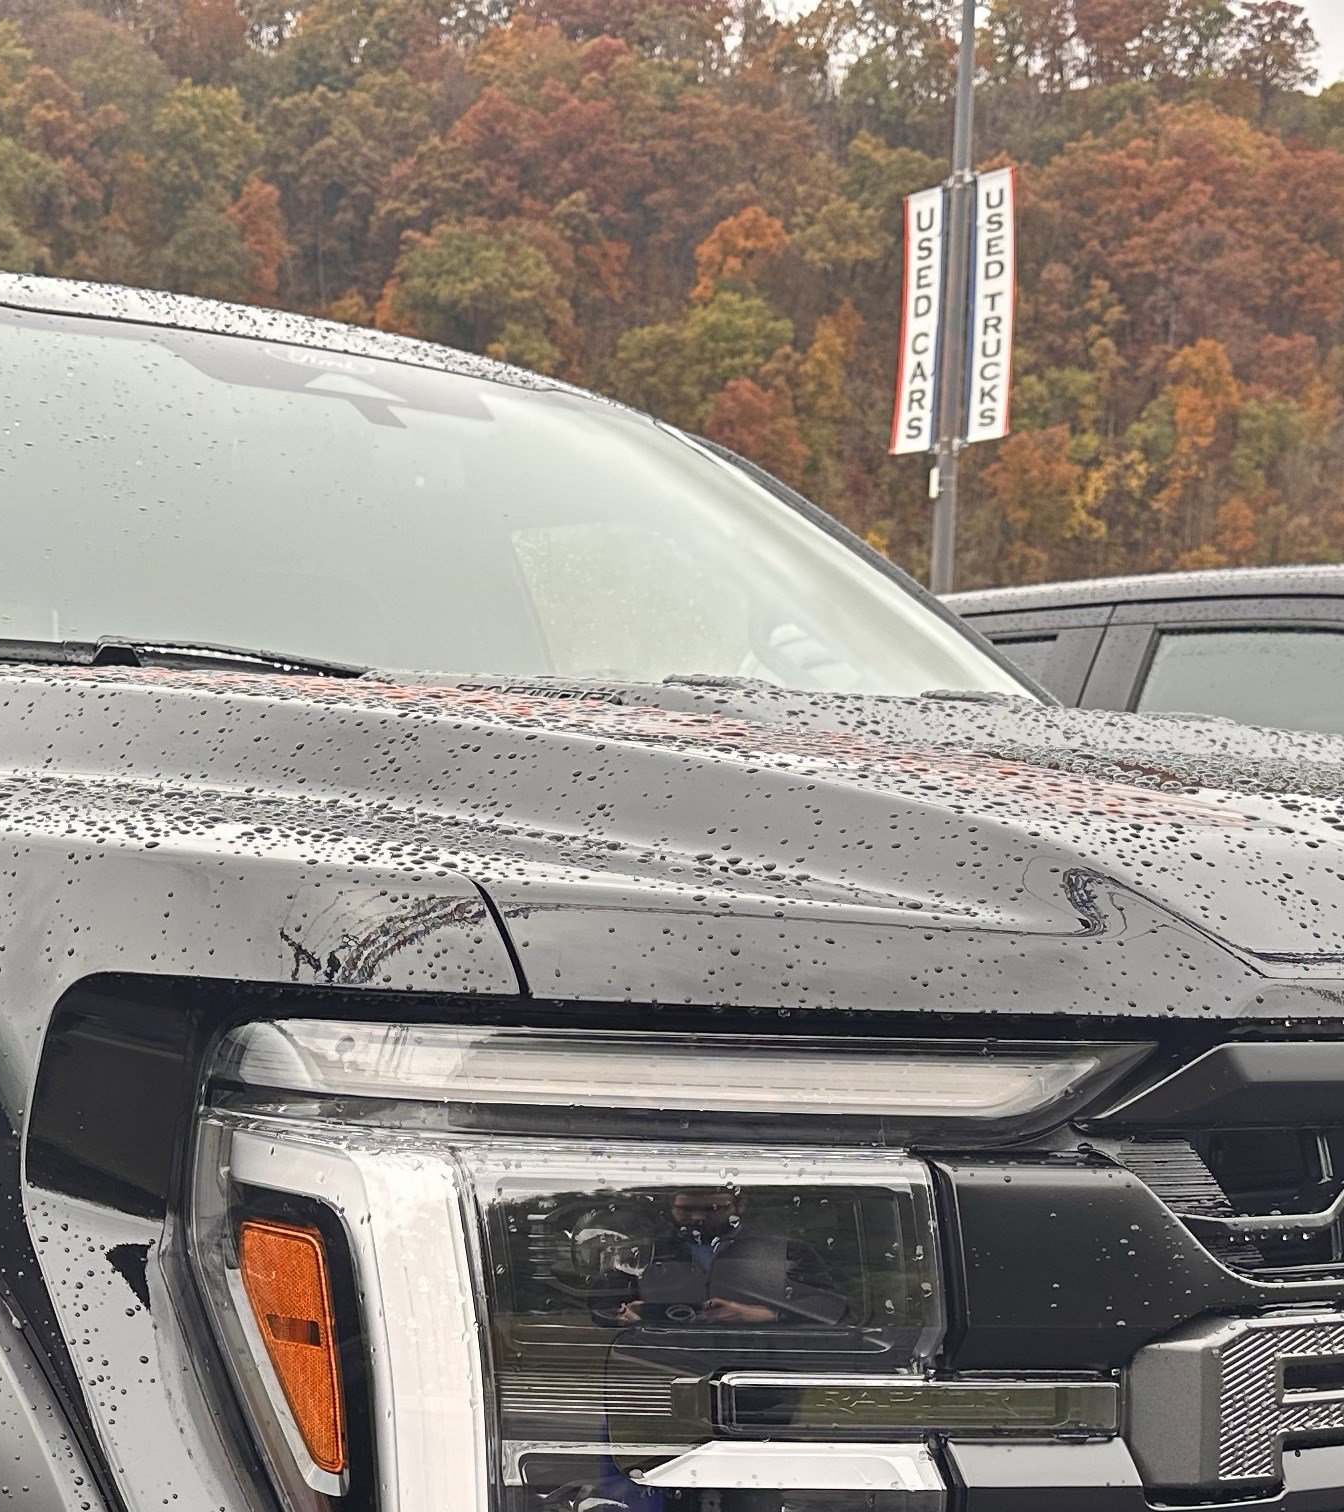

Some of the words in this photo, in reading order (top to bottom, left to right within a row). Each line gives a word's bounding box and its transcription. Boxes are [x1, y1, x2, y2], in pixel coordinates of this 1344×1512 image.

[913, 207, 934, 318] USED
[984, 188, 1004, 280] USED
[906, 333, 929, 439] CARS
[979, 293, 1002, 427] TRUCKS
